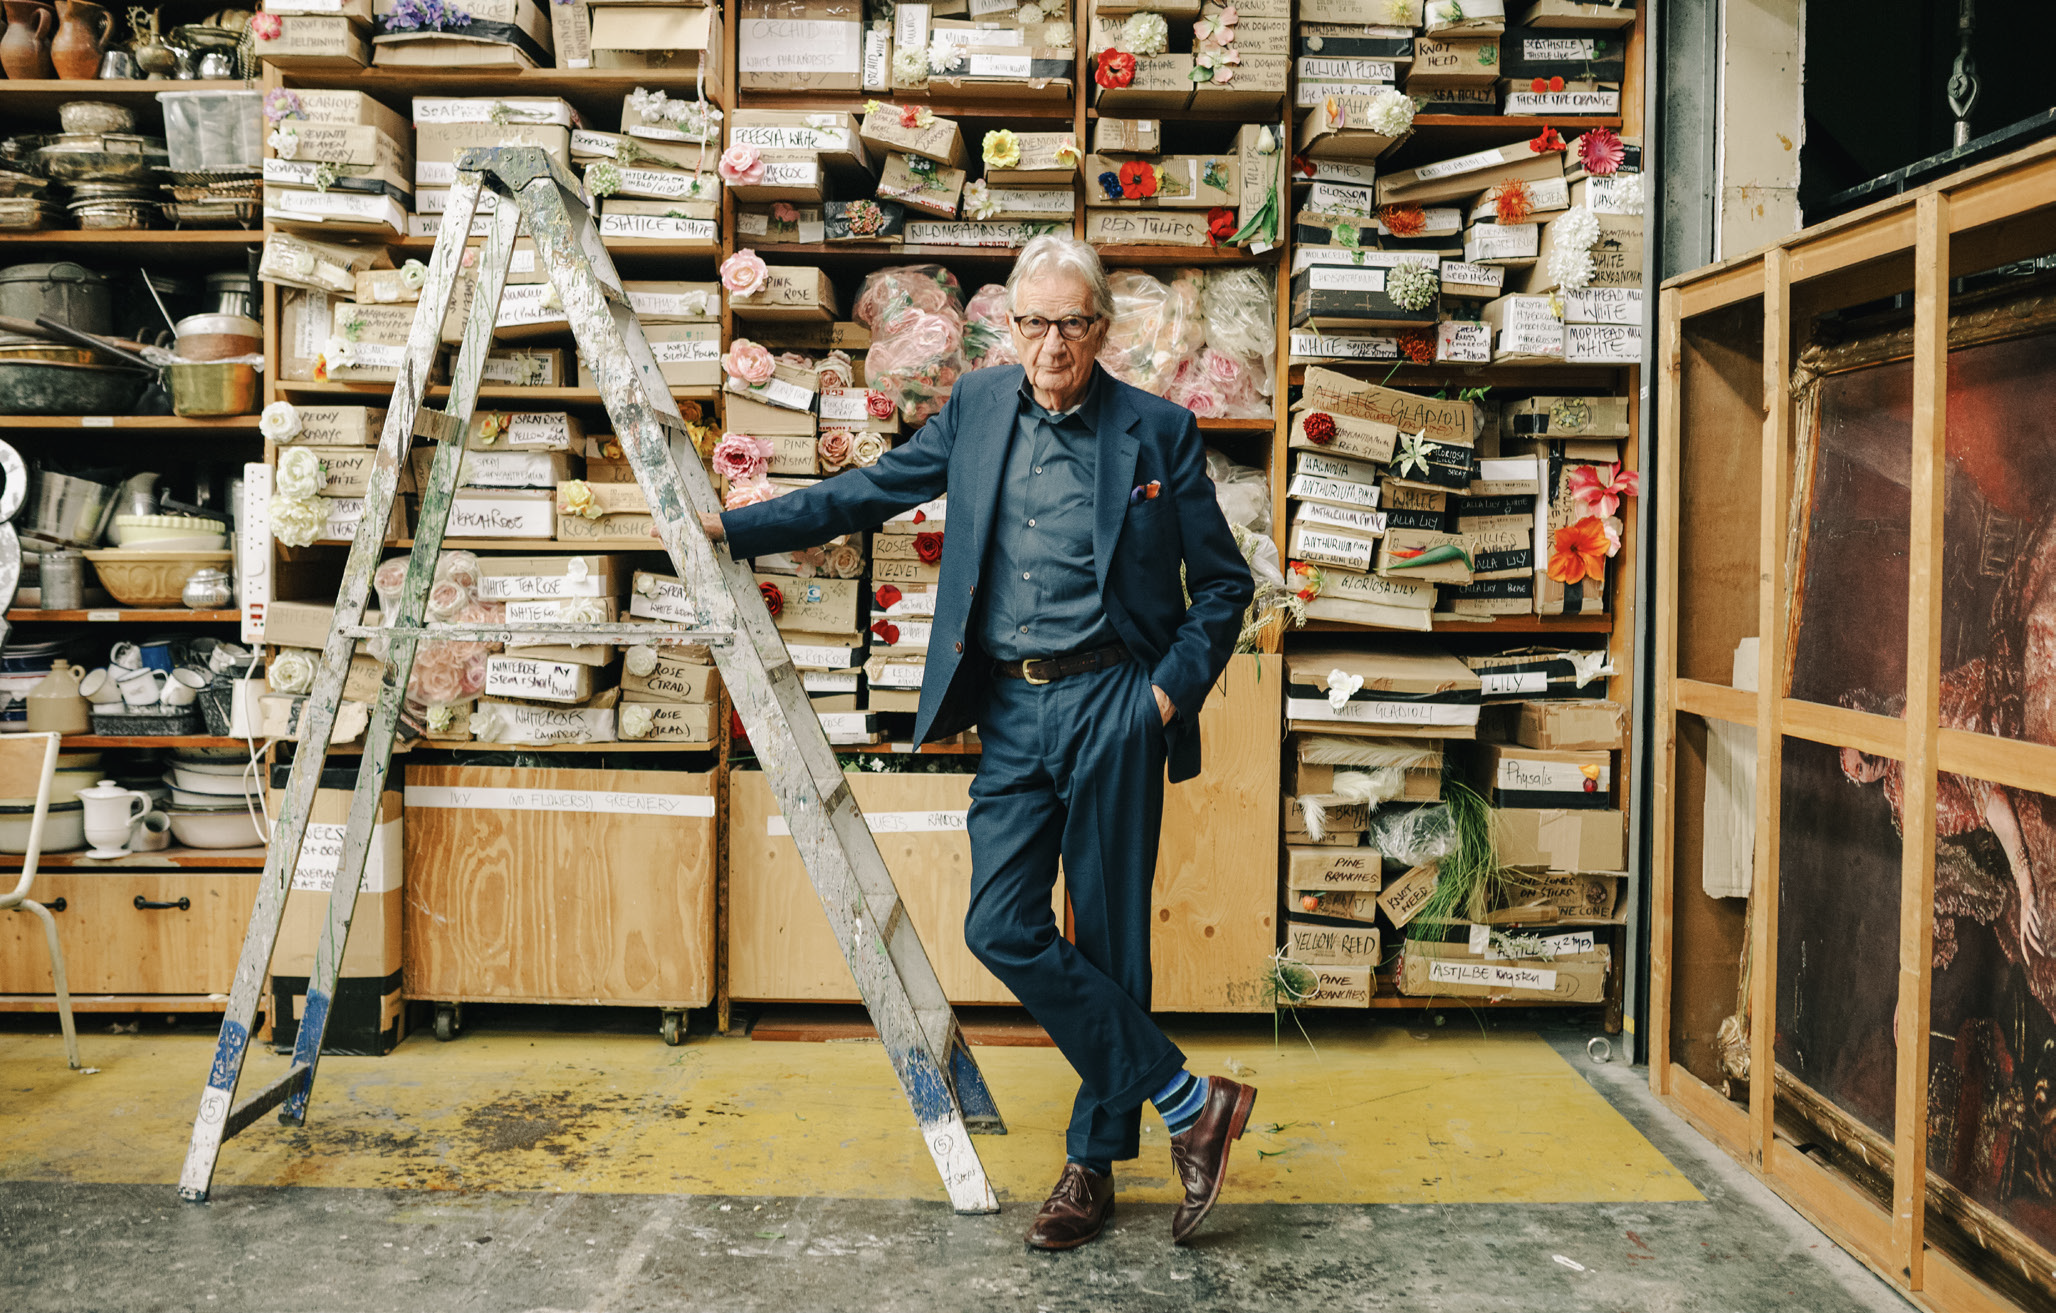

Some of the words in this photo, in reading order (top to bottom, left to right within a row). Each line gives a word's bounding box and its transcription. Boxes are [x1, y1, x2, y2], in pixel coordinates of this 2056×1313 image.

[751, 20, 820, 39] ORCHID
[1251, 21, 1288, 31] DOGWOOD
[1419, 42, 1451, 56] KNOT
[867, 53, 879, 86] ORCHID
[301, 96, 359, 110] SCABIOUS
[1319, 184, 1368, 201] BLOSSOM
[604, 214, 669, 232] STATICE
[674, 221, 713, 238] WHITE
[1100, 217, 1136, 232] RED
[1136, 217, 1194, 238] TULIPS
[1447, 263, 1491, 276] HONESTY
[765, 276, 793, 289] PINK
[783, 289, 811, 301] ROSE
[1583, 302, 1627, 323] WHITE
[1298, 336, 1342, 356] WHITE
[1576, 340, 1624, 356] WHITE
[301, 411, 340, 422] PEONY
[783, 440, 810, 450] PINK
[1302, 457, 1349, 475] MAGNOLIA
[562, 519, 599, 537] ROSE
[603, 519, 651, 537] BUSHE
[875, 538, 908, 554] ROSE
[1302, 535, 1353, 554] ANTHURIUM
[1506, 552, 1527, 568] LILY
[878, 566, 921, 579] VELVET
[481, 578, 512, 597] WHITE
[1341, 574, 1391, 594] GLORIOSA
[1392, 583, 1418, 597] LILY
[797, 591, 830, 606] RD
[653, 662, 686, 679] ROSE
[1490, 675, 1524, 694] LILY
[652, 708, 683, 721] ROSE
[1506, 760, 1554, 789] Physalis
[449, 792, 471, 806] IVY
[604, 793, 681, 812] GREENERY
[1334, 856, 1366, 870] PINE
[1293, 931, 1340, 951] YELLOW
[1341, 934, 1376, 956] REED
[1319, 973, 1353, 986] PINE
[1432, 962, 1490, 980] ASTILBE
